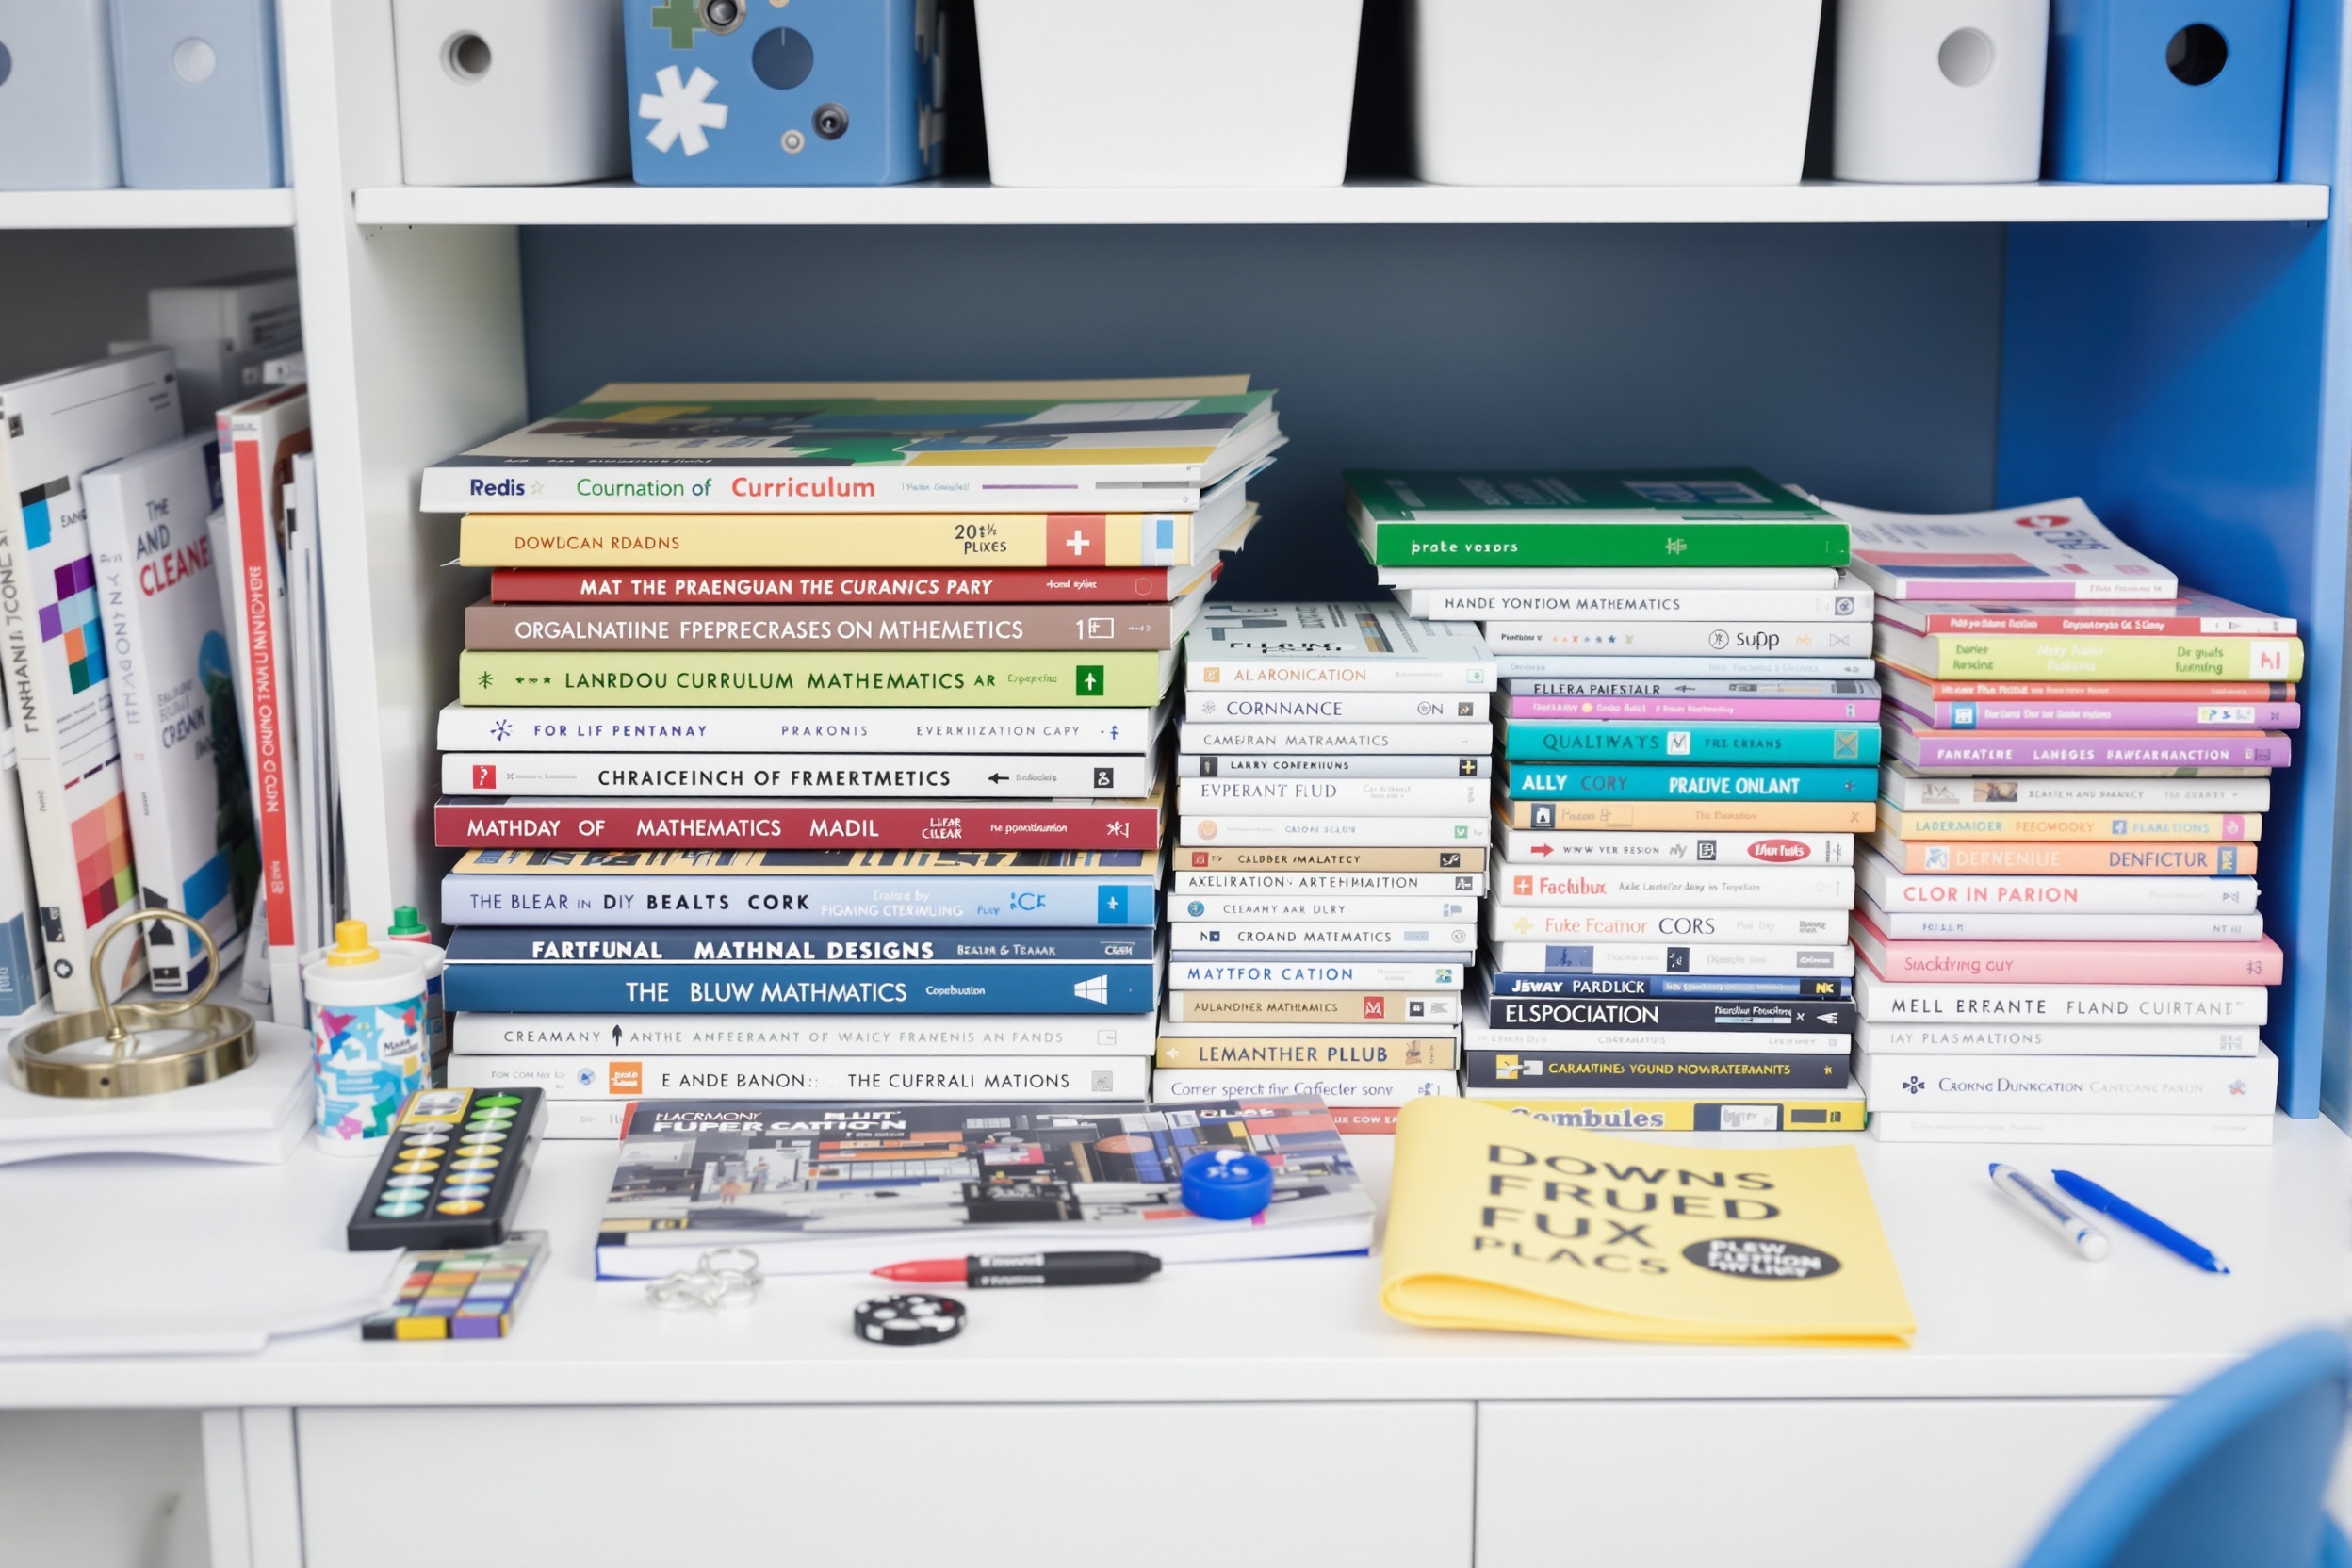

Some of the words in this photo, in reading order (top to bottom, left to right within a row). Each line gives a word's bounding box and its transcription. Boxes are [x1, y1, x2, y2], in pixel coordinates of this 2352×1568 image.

[471, 479, 525, 496] Redis
[578, 479, 683, 496] Cournation
[693, 478, 711, 496] of
[732, 477, 874, 497] Curriculum
[137, 524, 170, 561] AND
[580, 580, 622, 595] MAT
[631, 580, 666, 595] THE
[676, 580, 792, 595] PRAENGUAN
[800, 580, 833, 594] THE
[947, 580, 992, 594] PARY
[1576, 599, 1679, 610] MATHEMATICS
[681, 621, 831, 639] FPEPRECRASES
[838, 621, 872, 639] ON
[880, 621, 1022, 639] MTHEMETICS
[566, 673, 666, 688] LANRDOU
[677, 673, 793, 689] CURRULUM
[808, 674, 964, 689] MATHEMATICS
[974, 675, 995, 686] AR
[1227, 702, 1341, 715] CORNNANCE
[535, 726, 566, 736] FOR
[579, 726, 602, 736] LIF
[613, 726, 706, 736] PENTANAY
[1044, 727, 1079, 736] CAPY
[598, 771, 743, 785] CHRAICEINCH
[754, 771, 780, 785] OF
[792, 771, 950, 786] FRMERTMETICS
[1522, 775, 1567, 790] ALLY
[1581, 776, 1626, 791] CORY
[467, 820, 560, 836] MATHDAY
[579, 820, 605, 836] OF
[637, 820, 781, 836] MATHEMATICS
[810, 819, 878, 837] MADIL
[2110, 852, 2207, 867] DENFICTUR
[470, 894, 501, 908] THE
[512, 895, 567, 908] BLEAR
[604, 895, 633, 909] DIY
[647, 895, 728, 909] BEALTS
[748, 895, 808, 909] CORK
[1903, 887, 1957, 901] CLOR
[1968, 888, 1987, 901] IN
[1999, 888, 2077, 902] PARION
[1659, 918, 1714, 934] CORS
[1238, 932, 1296, 941] CROAND
[533, 941, 662, 958] FARTFUNAL
[694, 941, 815, 958] MATHNAL
[827, 942, 934, 959] DESIGNS
[1188, 968, 1271, 980] MAYTFOR
[1282, 969, 1352, 980] CATION
[626, 983, 668, 1001] THE
[691, 983, 754, 1002] BLUW
[761, 983, 906, 1002] MATHMATICS
[1507, 1004, 1658, 1023] ELSPOCIATION
[1892, 999, 1942, 1012] MELL
[2067, 1001, 2128, 1014] FLAND
[809, 1033, 827, 1042] OF
[984, 1033, 1004, 1042] AN
[1200, 1047, 1317, 1061] LEMANTHER
[663, 1074, 670, 1086] E
[679, 1074, 728, 1086] ANDE
[848, 1074, 880, 1086] THE
[985, 1074, 1069, 1087] MATIONS
[1488, 1144, 1776, 1190] DOWNS
[1489, 1175, 1782, 1221] FRUED
[1481, 1206, 1654, 1248] FUX
[1474, 1237, 1671, 1275] PLACS
